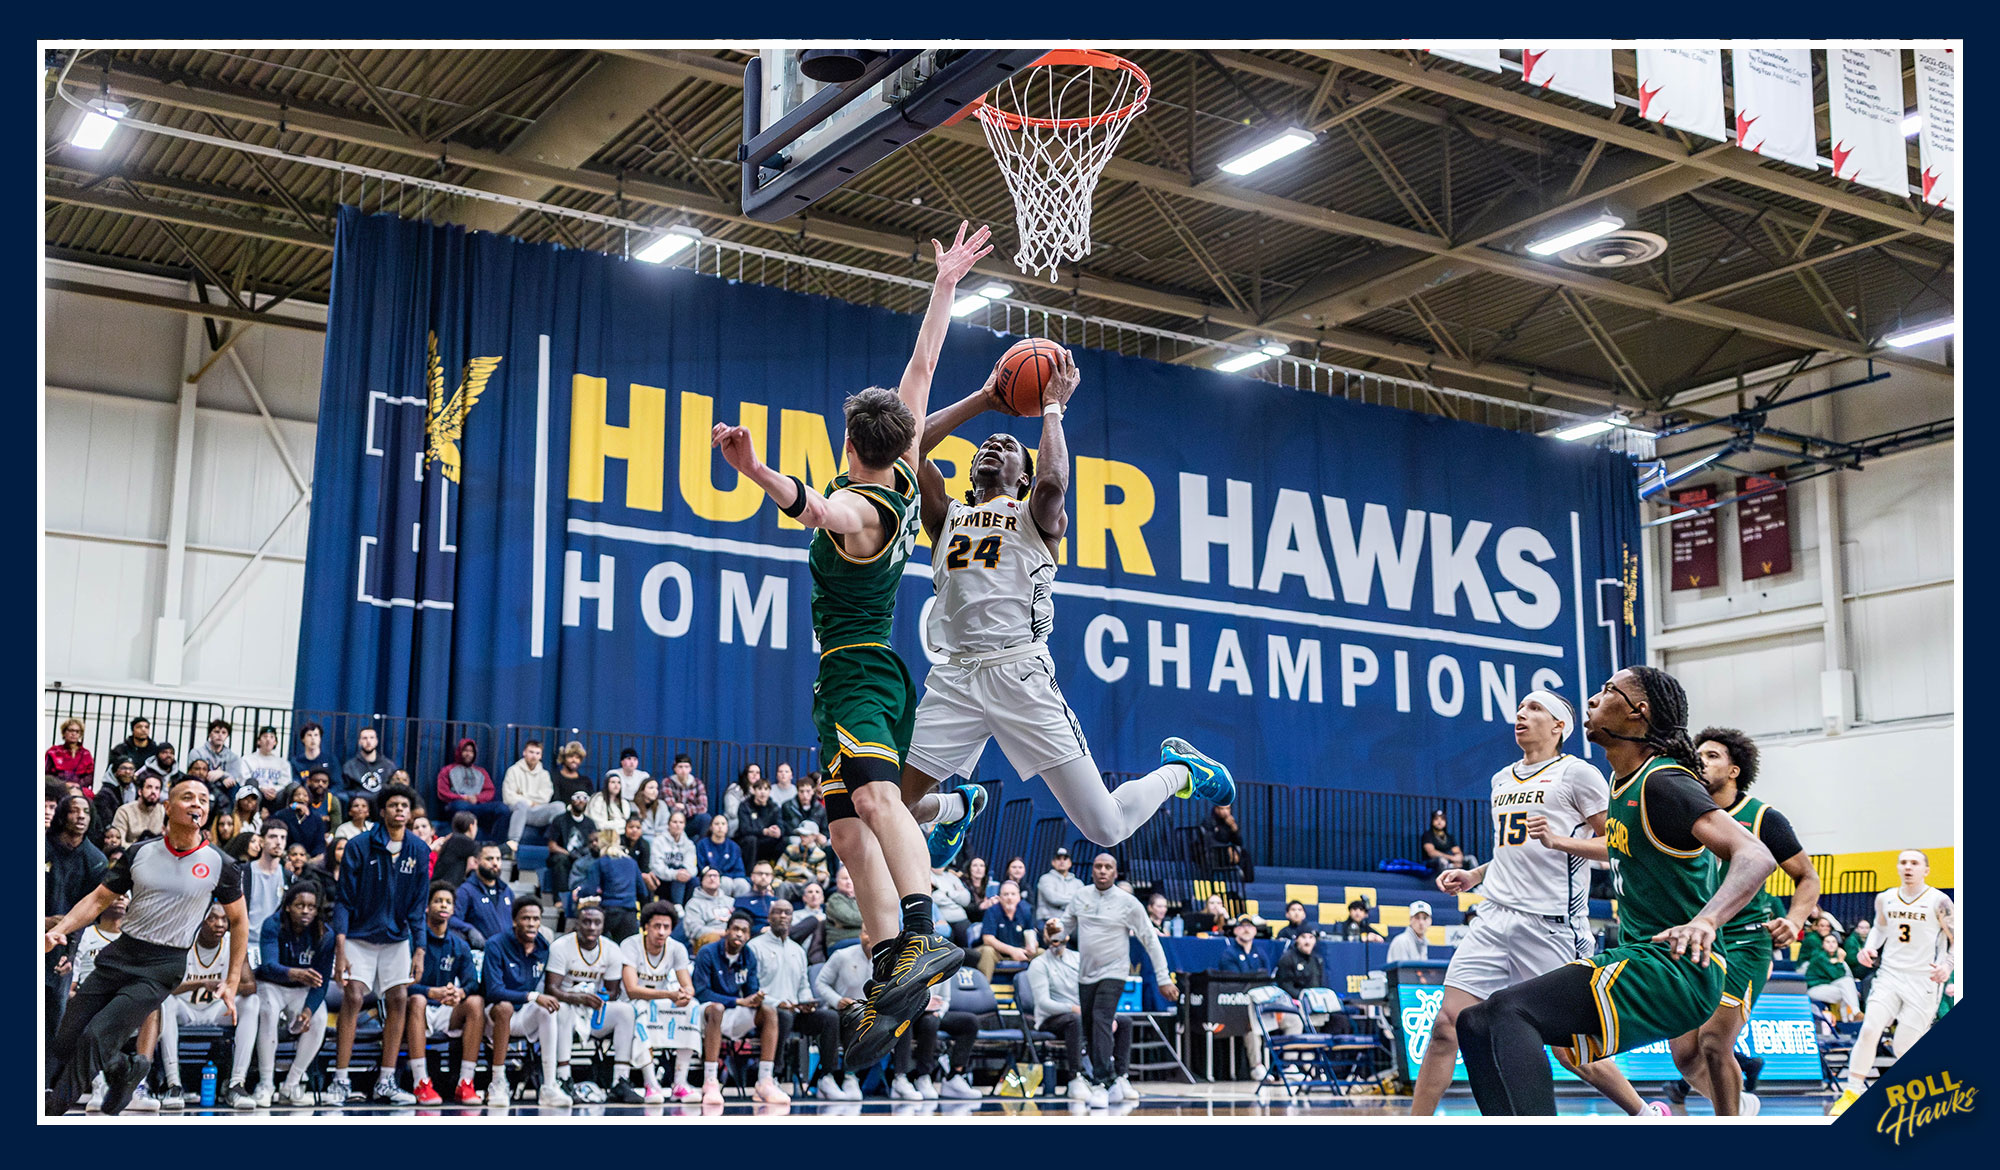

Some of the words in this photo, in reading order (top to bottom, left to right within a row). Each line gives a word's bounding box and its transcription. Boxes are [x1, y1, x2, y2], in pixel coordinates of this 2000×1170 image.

[946, 533, 1003, 570] 24
[1179, 472, 1562, 631] HAWKS
[563, 550, 821, 654] HOM
[1498, 811, 1529, 847] 15
[1898, 923, 1911, 944] 3
[1751, 1020, 1819, 1055] IGNITE
